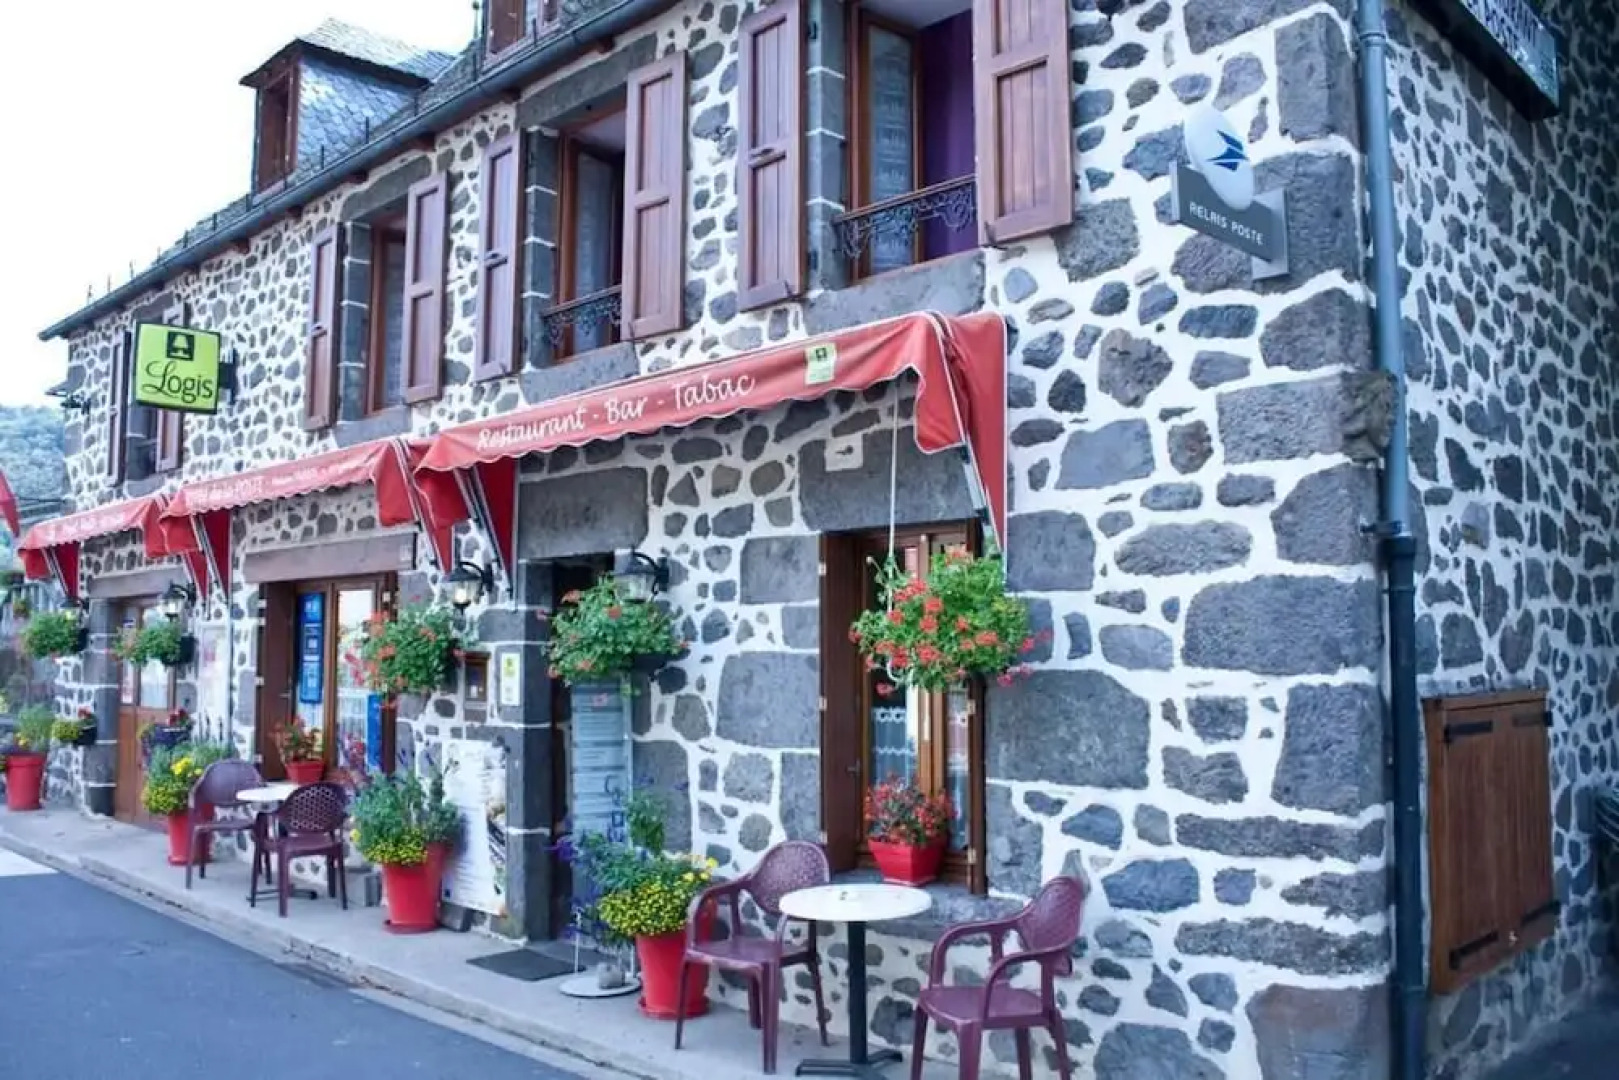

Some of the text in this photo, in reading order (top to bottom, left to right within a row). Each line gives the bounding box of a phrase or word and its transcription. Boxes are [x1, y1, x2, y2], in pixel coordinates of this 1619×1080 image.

[1189, 201, 1264, 246] RELAIS POSTE
[141, 360, 214, 404] Logis
[477, 405, 587, 451] Restaurant
[604, 396, 649, 425] Bar
[670, 373, 756, 411] Tabac
